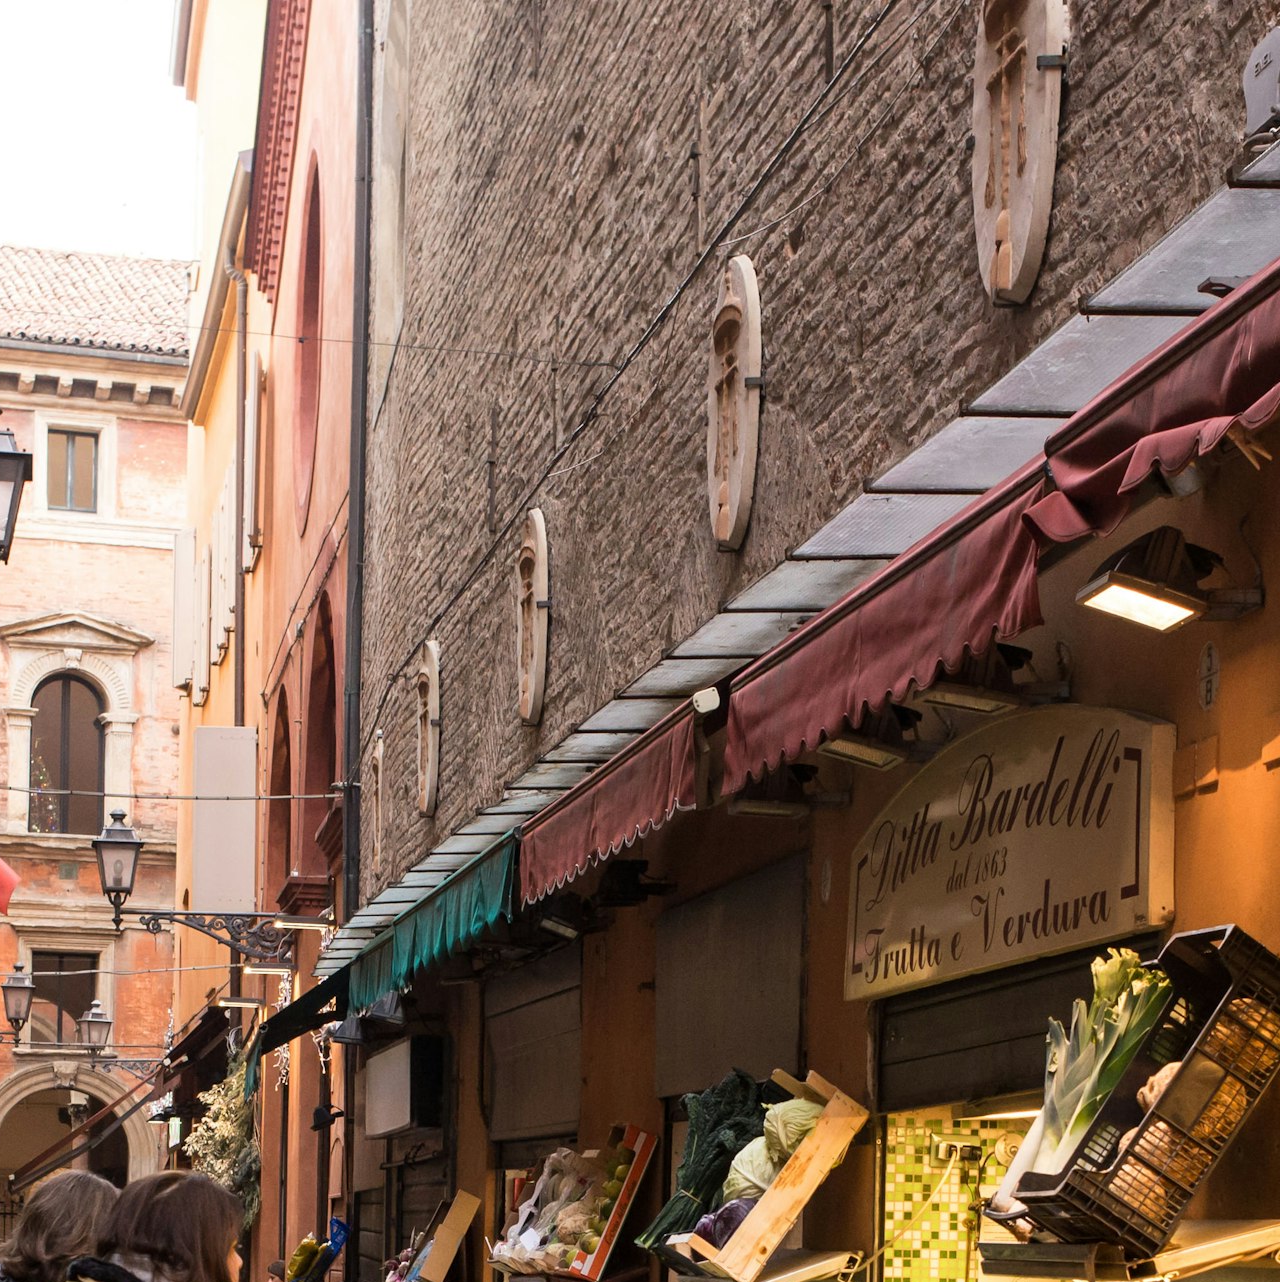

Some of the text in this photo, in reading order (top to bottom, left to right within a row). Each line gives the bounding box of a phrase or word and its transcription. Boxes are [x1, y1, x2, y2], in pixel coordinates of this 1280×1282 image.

[865, 728, 1121, 912] Ditta Bardelli
[945, 846, 1009, 894] dal 1863
[864, 879, 1113, 984] Frutta e Verdura
